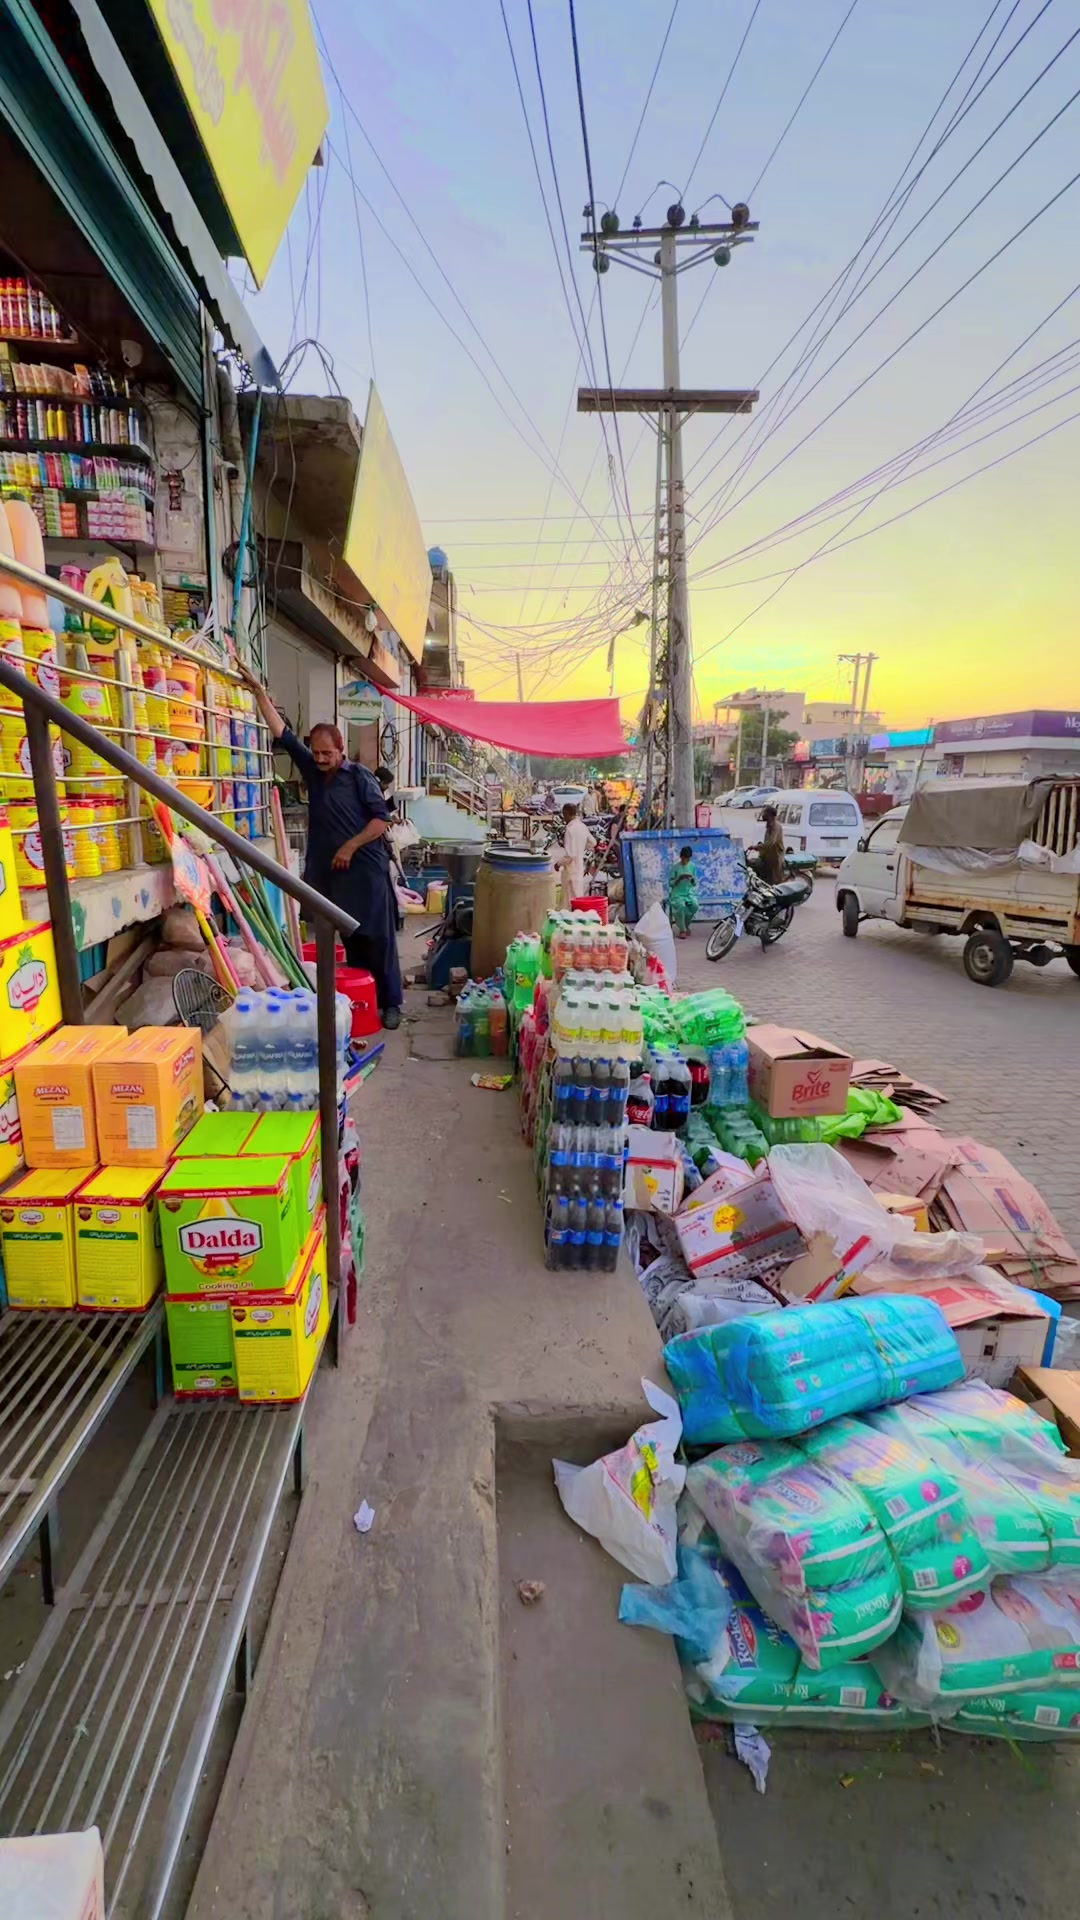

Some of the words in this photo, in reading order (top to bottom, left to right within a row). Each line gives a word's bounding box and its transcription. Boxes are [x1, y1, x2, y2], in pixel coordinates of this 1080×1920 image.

[35, 1086, 69, 1095] MEZAN
[112, 1085, 143, 1093] MEZAN
[792, 1081, 831, 1101] Brite
[187, 1229, 256, 1249] Dalda
[198, 1281, 239, 1291] Cooking
[240, 1280, 253, 1288] Oil
[855, 1592, 890, 1622] Rocket
